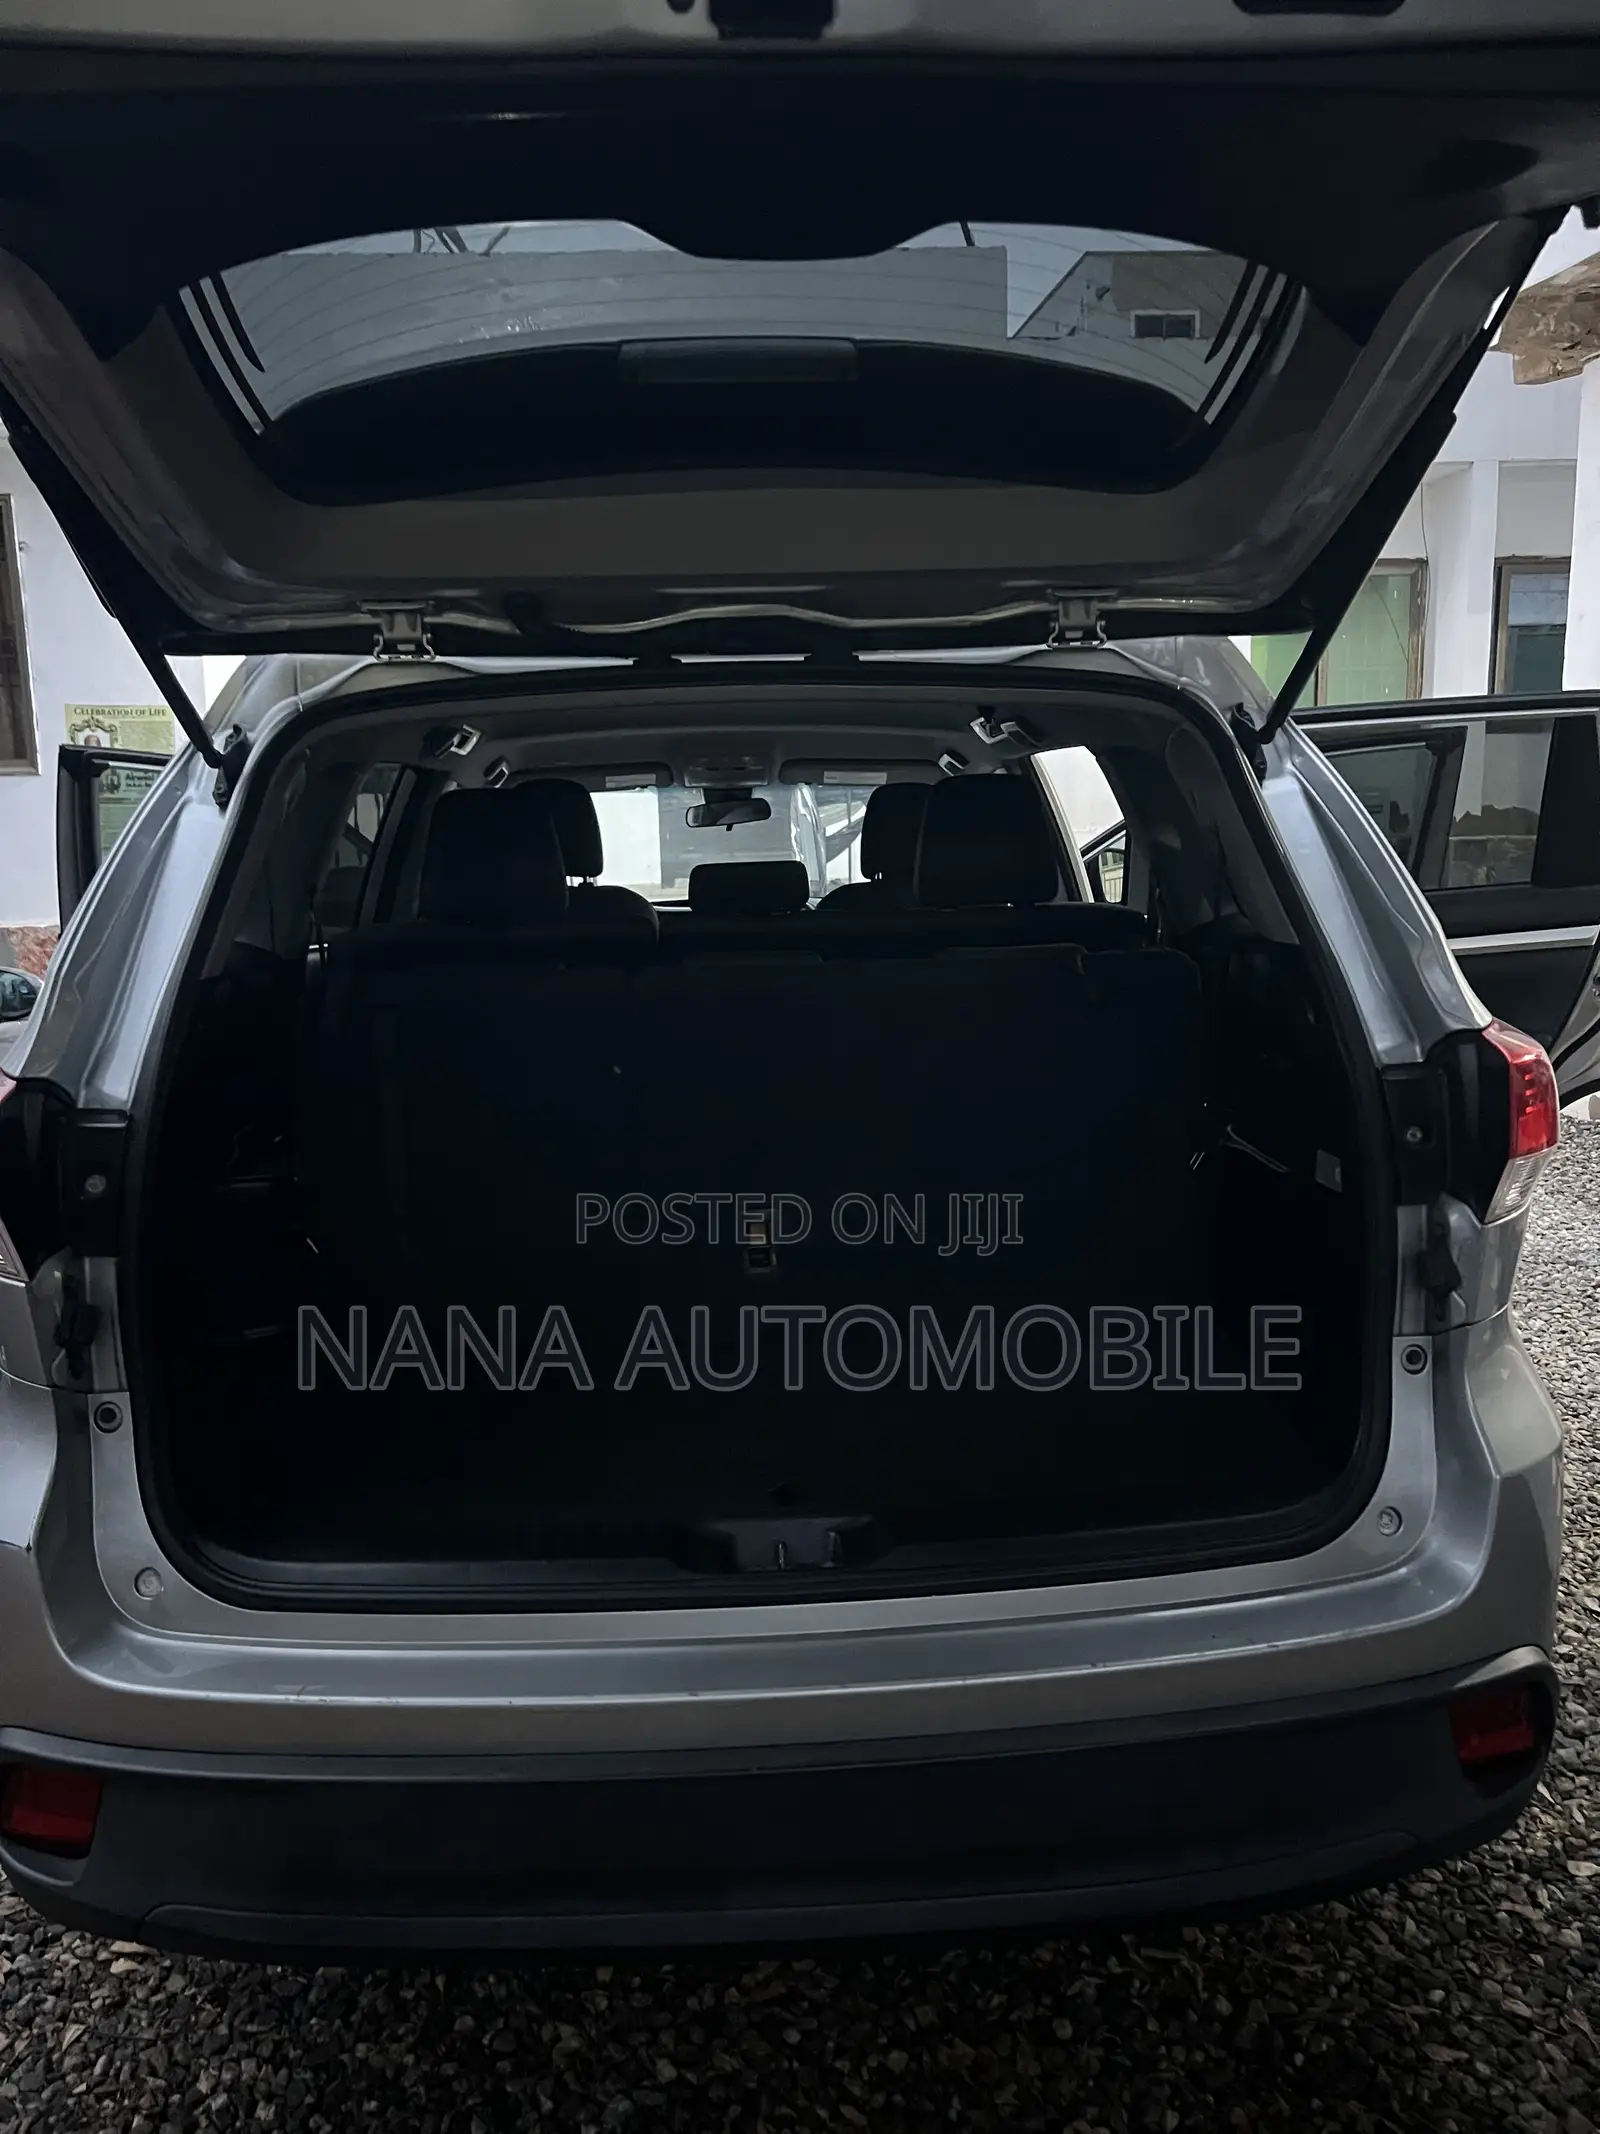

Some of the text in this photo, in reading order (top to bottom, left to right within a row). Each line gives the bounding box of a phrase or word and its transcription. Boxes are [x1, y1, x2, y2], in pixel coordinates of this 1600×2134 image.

[74, 707, 167, 717] CELEBRATION OF LIFE
